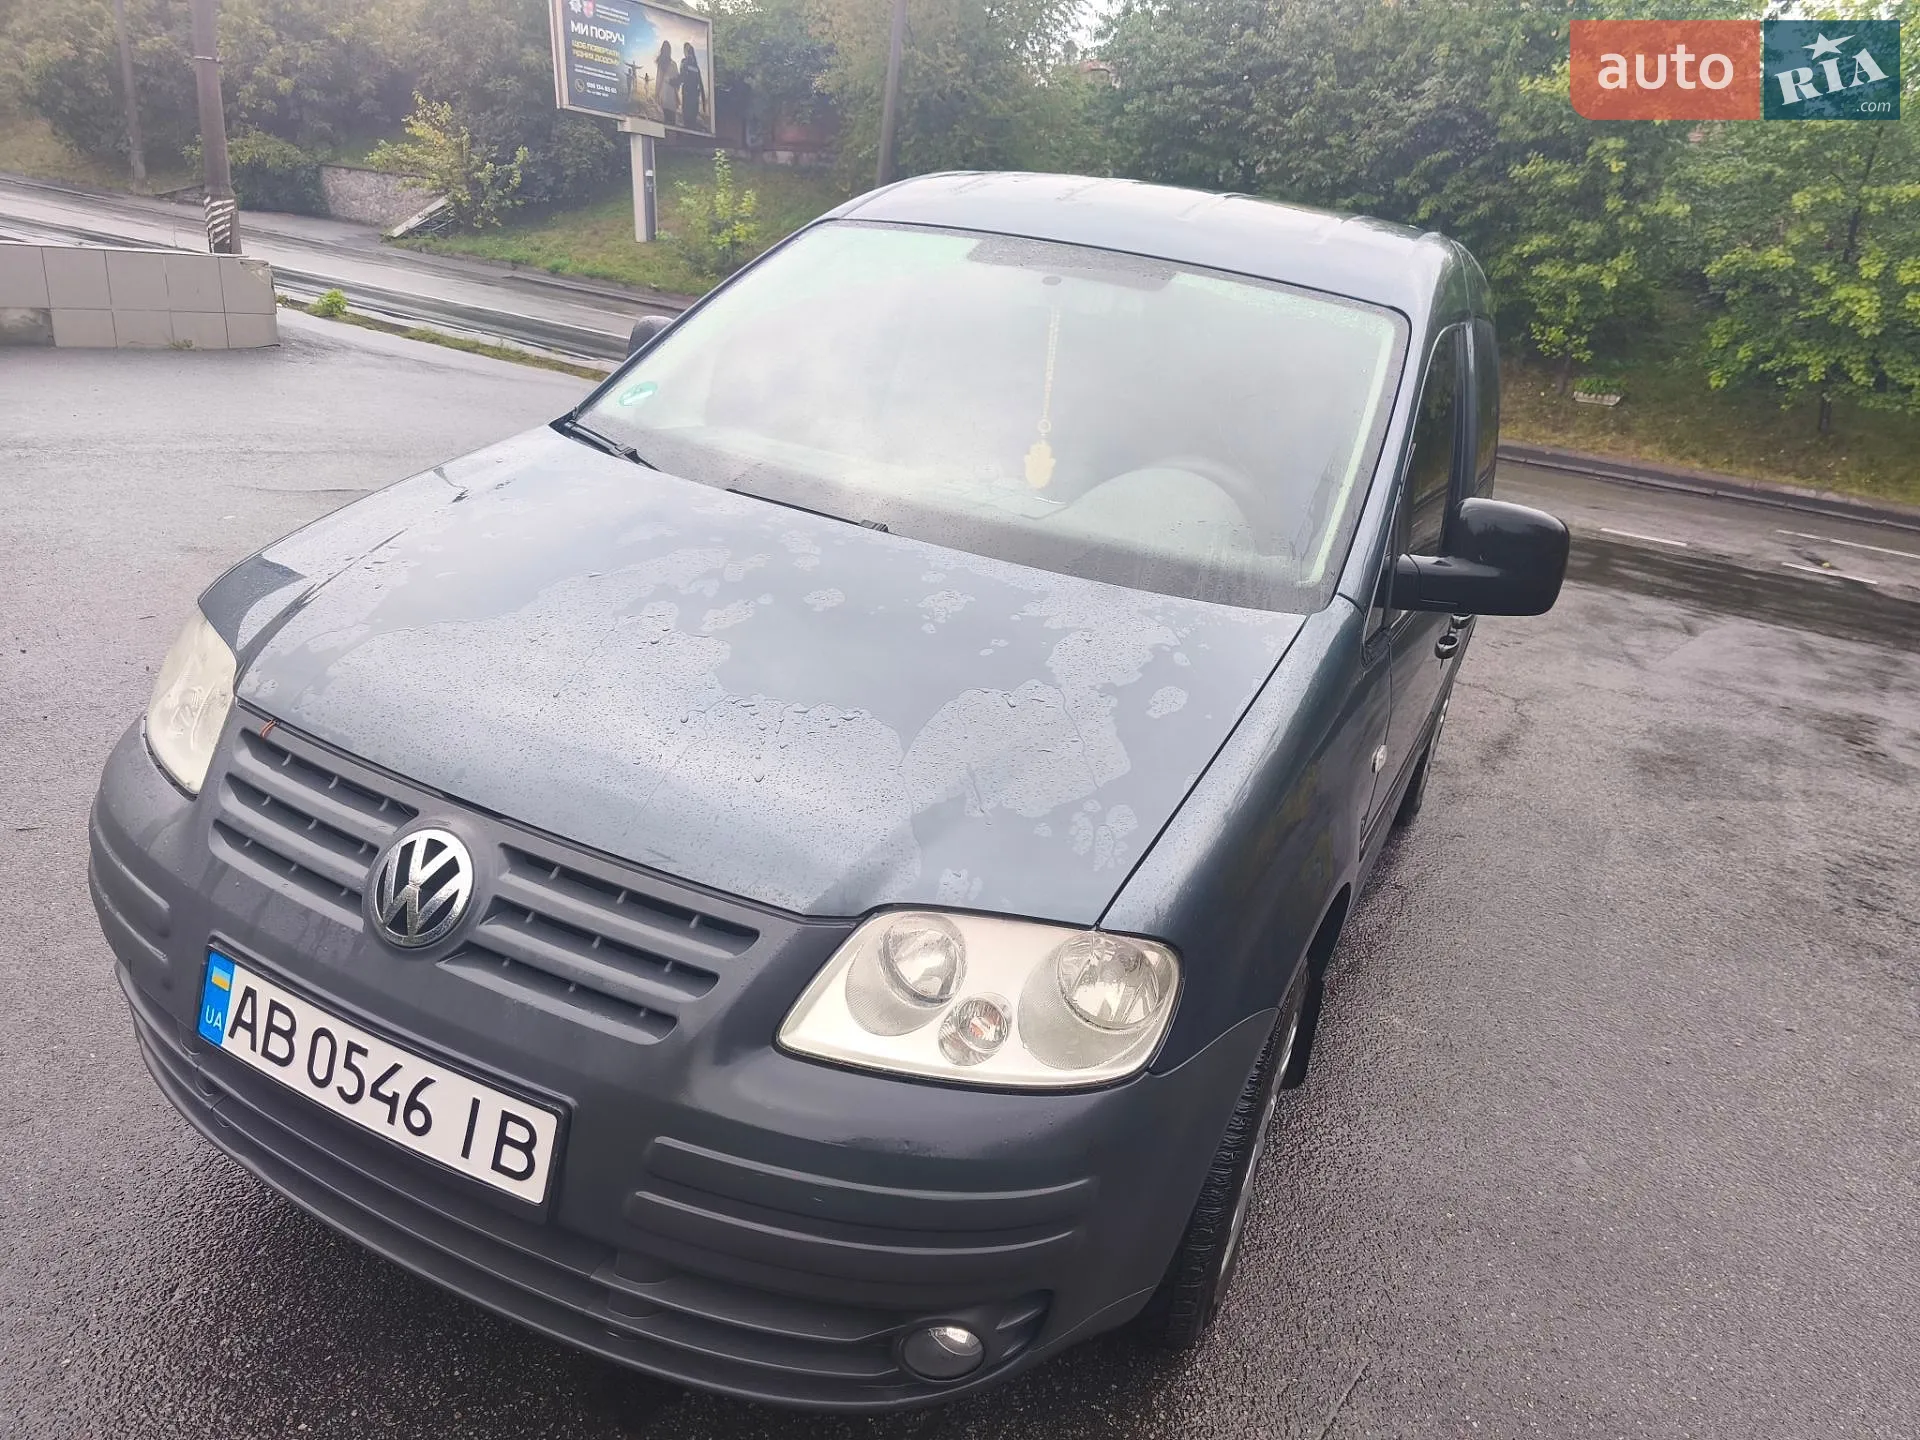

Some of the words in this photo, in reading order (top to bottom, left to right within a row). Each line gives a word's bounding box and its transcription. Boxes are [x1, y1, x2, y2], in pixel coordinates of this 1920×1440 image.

[570, 19, 588, 36] МИ
[590, 26, 625, 45] ПОРУЧ
[204, 1005, 223, 1030] UA
[228, 984, 297, 1068] AB
[307, 1026, 438, 1137] 0546
[460, 1096, 538, 1181] IB
